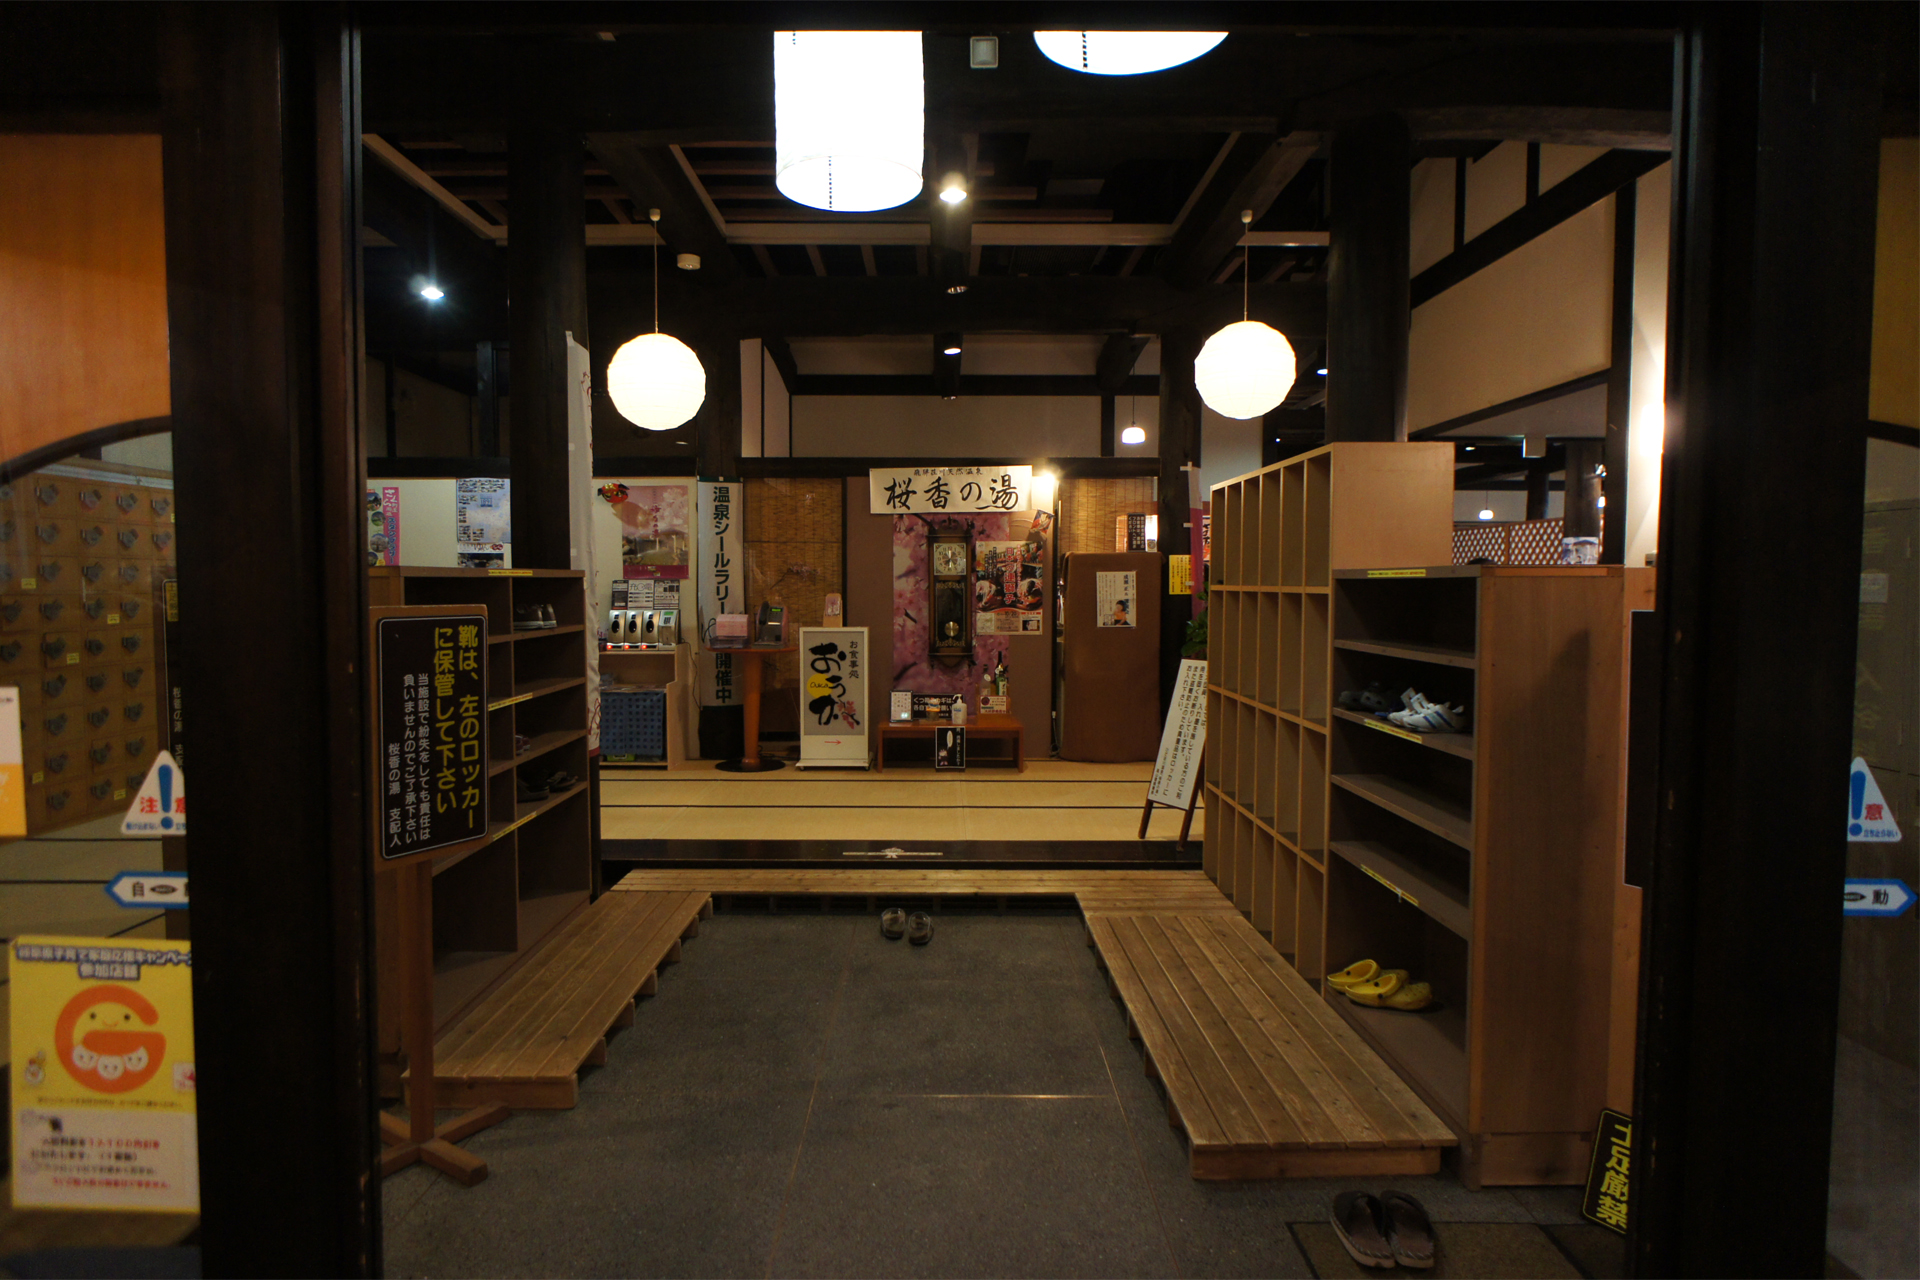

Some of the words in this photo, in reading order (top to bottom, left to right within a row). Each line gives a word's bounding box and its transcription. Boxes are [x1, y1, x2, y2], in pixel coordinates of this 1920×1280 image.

[884, 474, 1019, 511] 桜香の湯
[715, 653, 732, 704] 開催中
[849, 641, 859, 678] お食事処
[433, 627, 458, 815] に保管して下さい
[457, 625, 481, 830] 靴は、左のロッカー
[402, 674, 418, 845] 負いませんのでご了承下さい
[416, 673, 431, 841] 当施設で紛失をしても責任は
[1864, 803, 1883, 821] 意
[1872, 889, 1889, 905] 動
